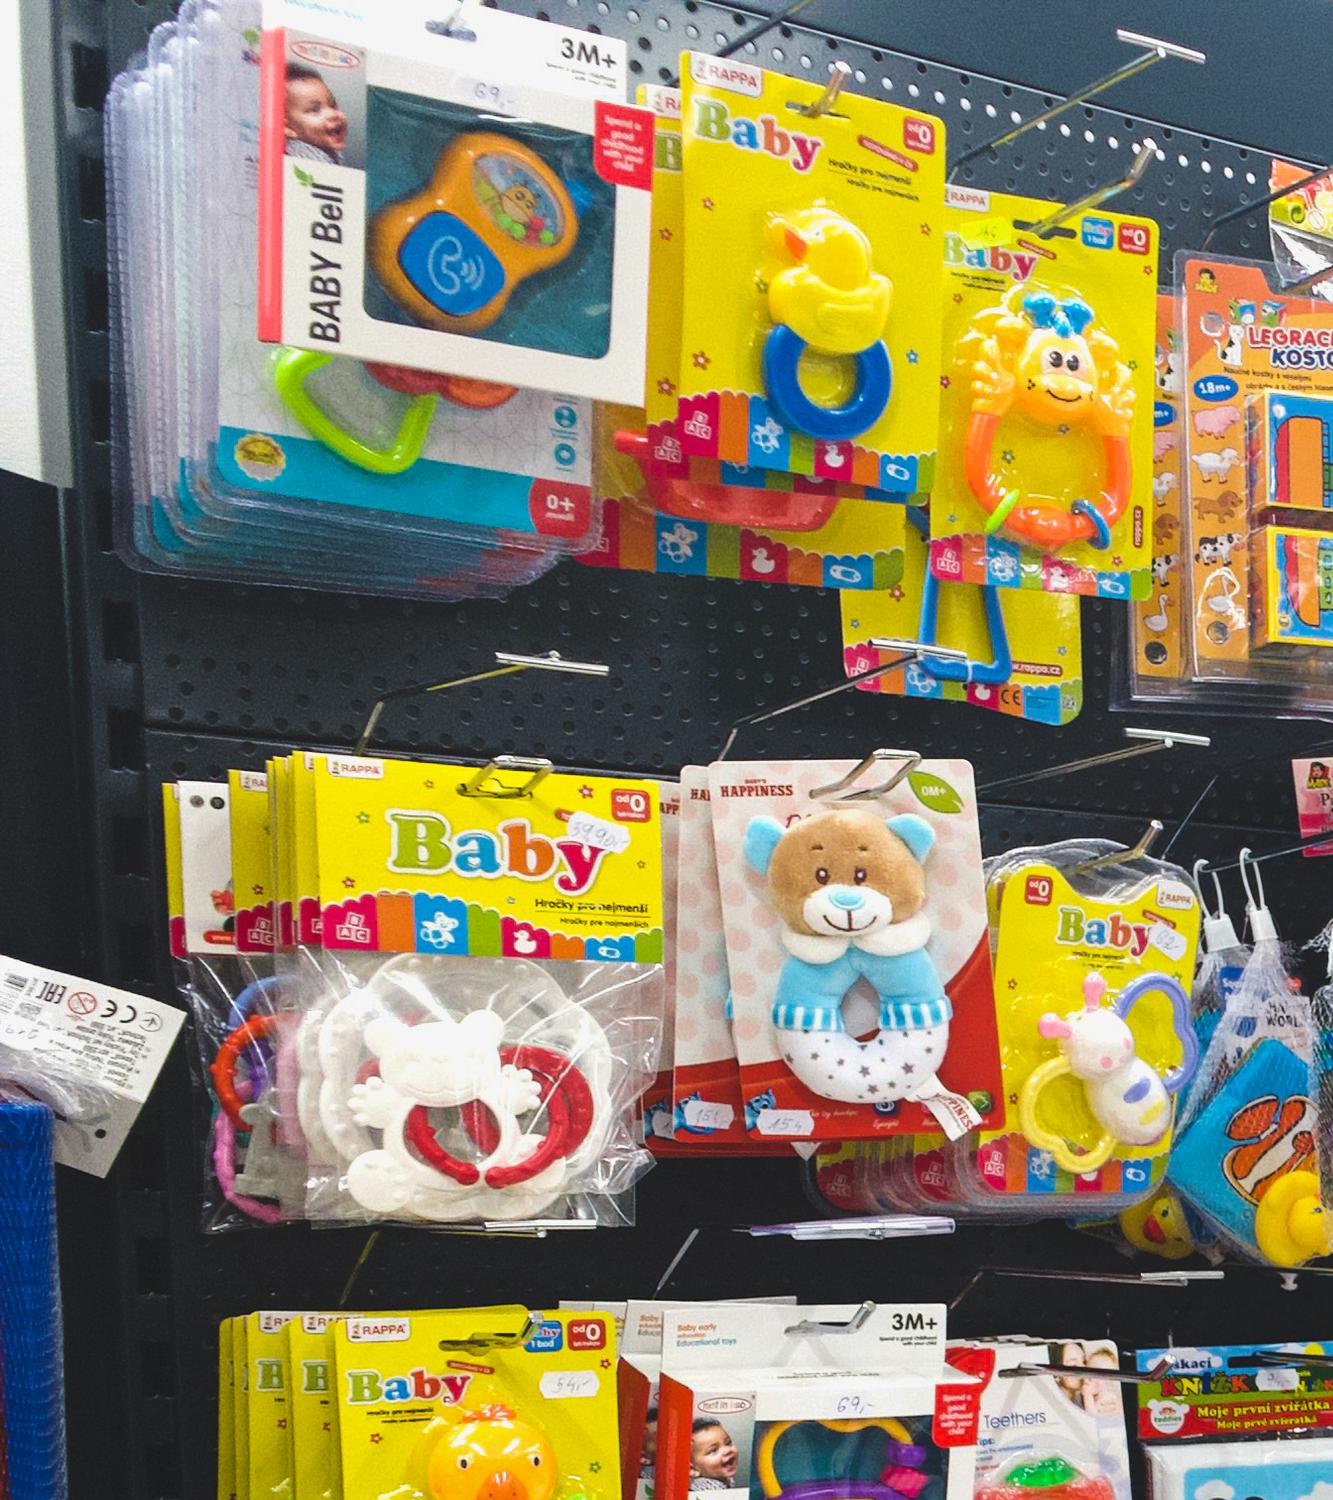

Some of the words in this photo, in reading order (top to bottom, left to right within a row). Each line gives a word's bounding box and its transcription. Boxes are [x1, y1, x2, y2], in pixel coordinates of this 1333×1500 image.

[561, 38, 617, 69] 3M+
[709, 65, 757, 88] RAPPA
[694, 99, 824, 172] Baby
[919, 125, 931, 143] 0
[950, 191, 986, 206] RAPPA
[310, 183, 344, 244] Bell
[1134, 231, 1147, 246] 0
[944, 232, 1037, 281] Baby
[309, 252, 342, 344] BABY
[1198, 381, 1231, 395] 18m+
[546, 494, 576, 512] 0+
[340, 762, 382, 777] RAPPA
[720, 785, 794, 798] HAPPINESS
[629, 795, 645, 812] 0
[390, 812, 605, 892] Baby
[1038, 880, 1049, 897] 0
[535, 898, 574, 913] Hračky
[1058, 907, 1150, 957] Baby
[362, 1324, 406, 1336] RAPPA
[891, 1312, 938, 1332] 3M+
[585, 1323, 600, 1340] 0
[349, 1368, 471, 1403] Baby
[1197, 1406, 1230, 1418] Moje
[1233, 1404, 1271, 1417] první
[1274, 1400, 1331, 1414] zvířátka
[983, 1411, 1047, 1429] Teethers
[1217, 1420, 1241, 1431] Moje
[1243, 1418, 1267, 1430] prvé
